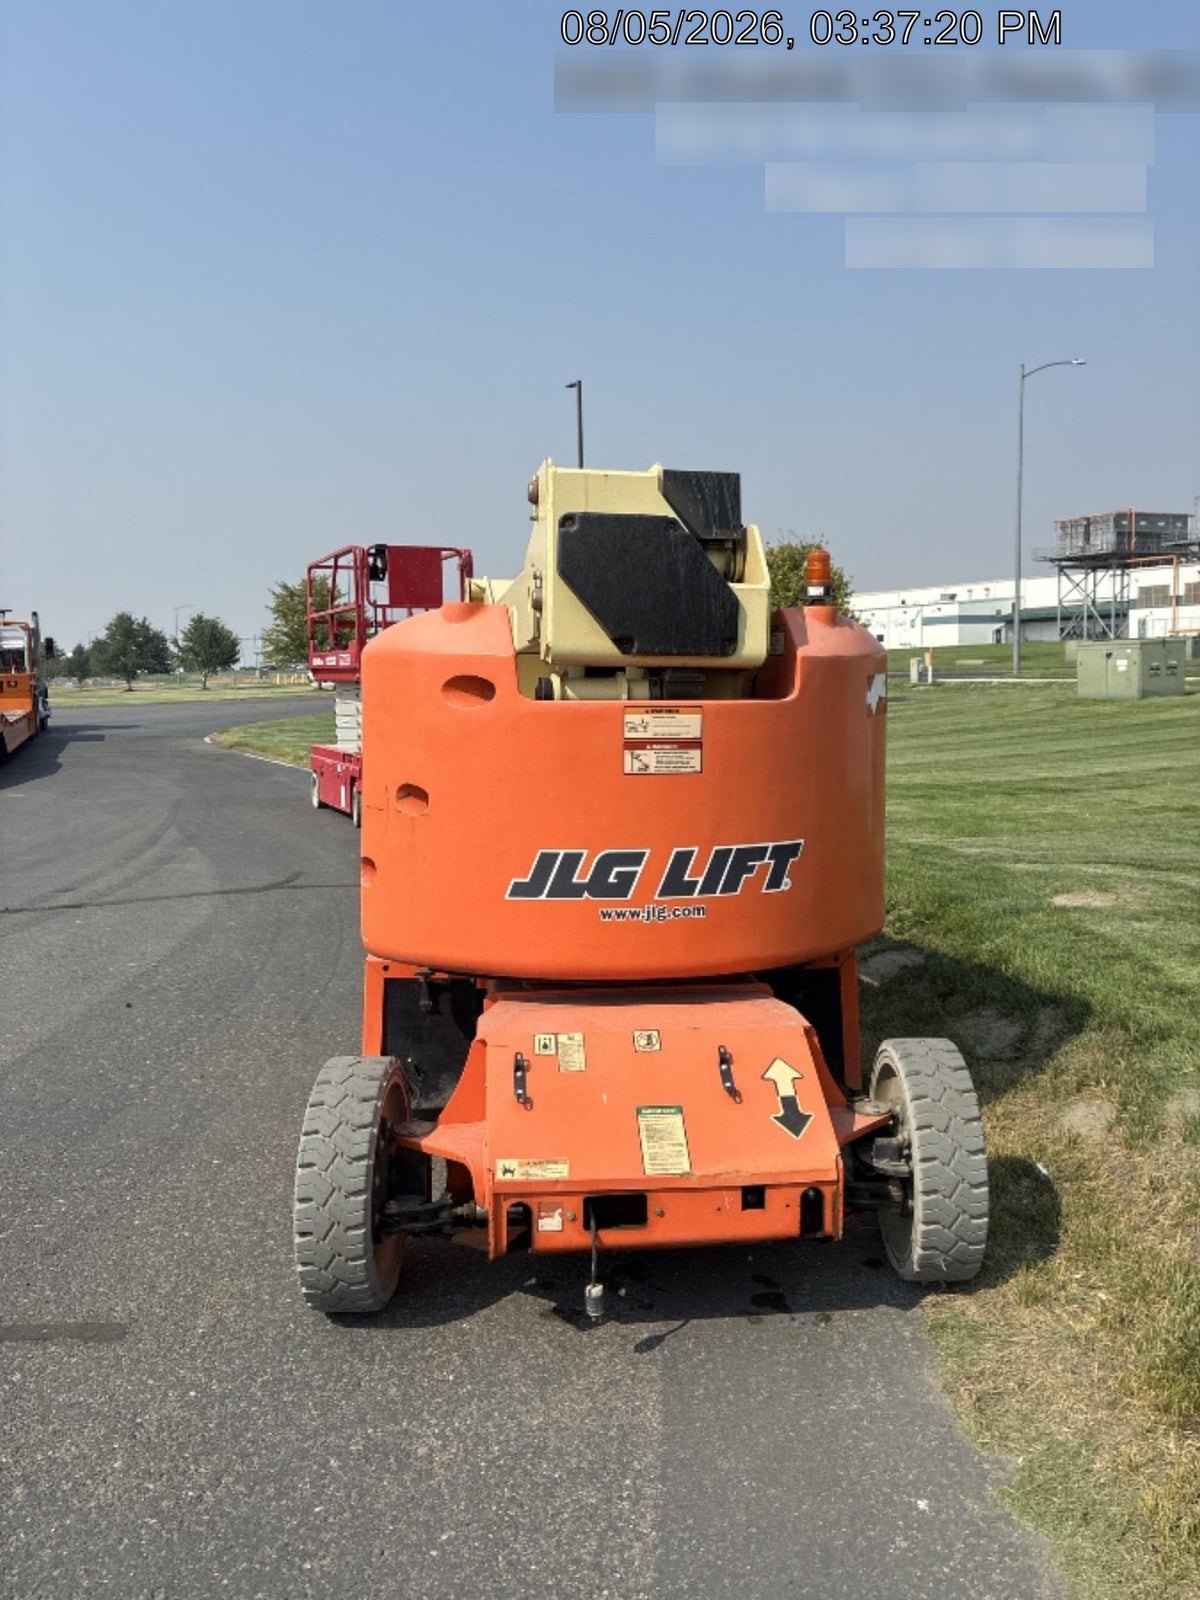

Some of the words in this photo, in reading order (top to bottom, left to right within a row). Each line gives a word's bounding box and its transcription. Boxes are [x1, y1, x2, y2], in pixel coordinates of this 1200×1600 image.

[505, 848, 650, 899] JLG
[654, 839, 804, 899] LIFT
[599, 905, 706, 922] www.jlg.com
